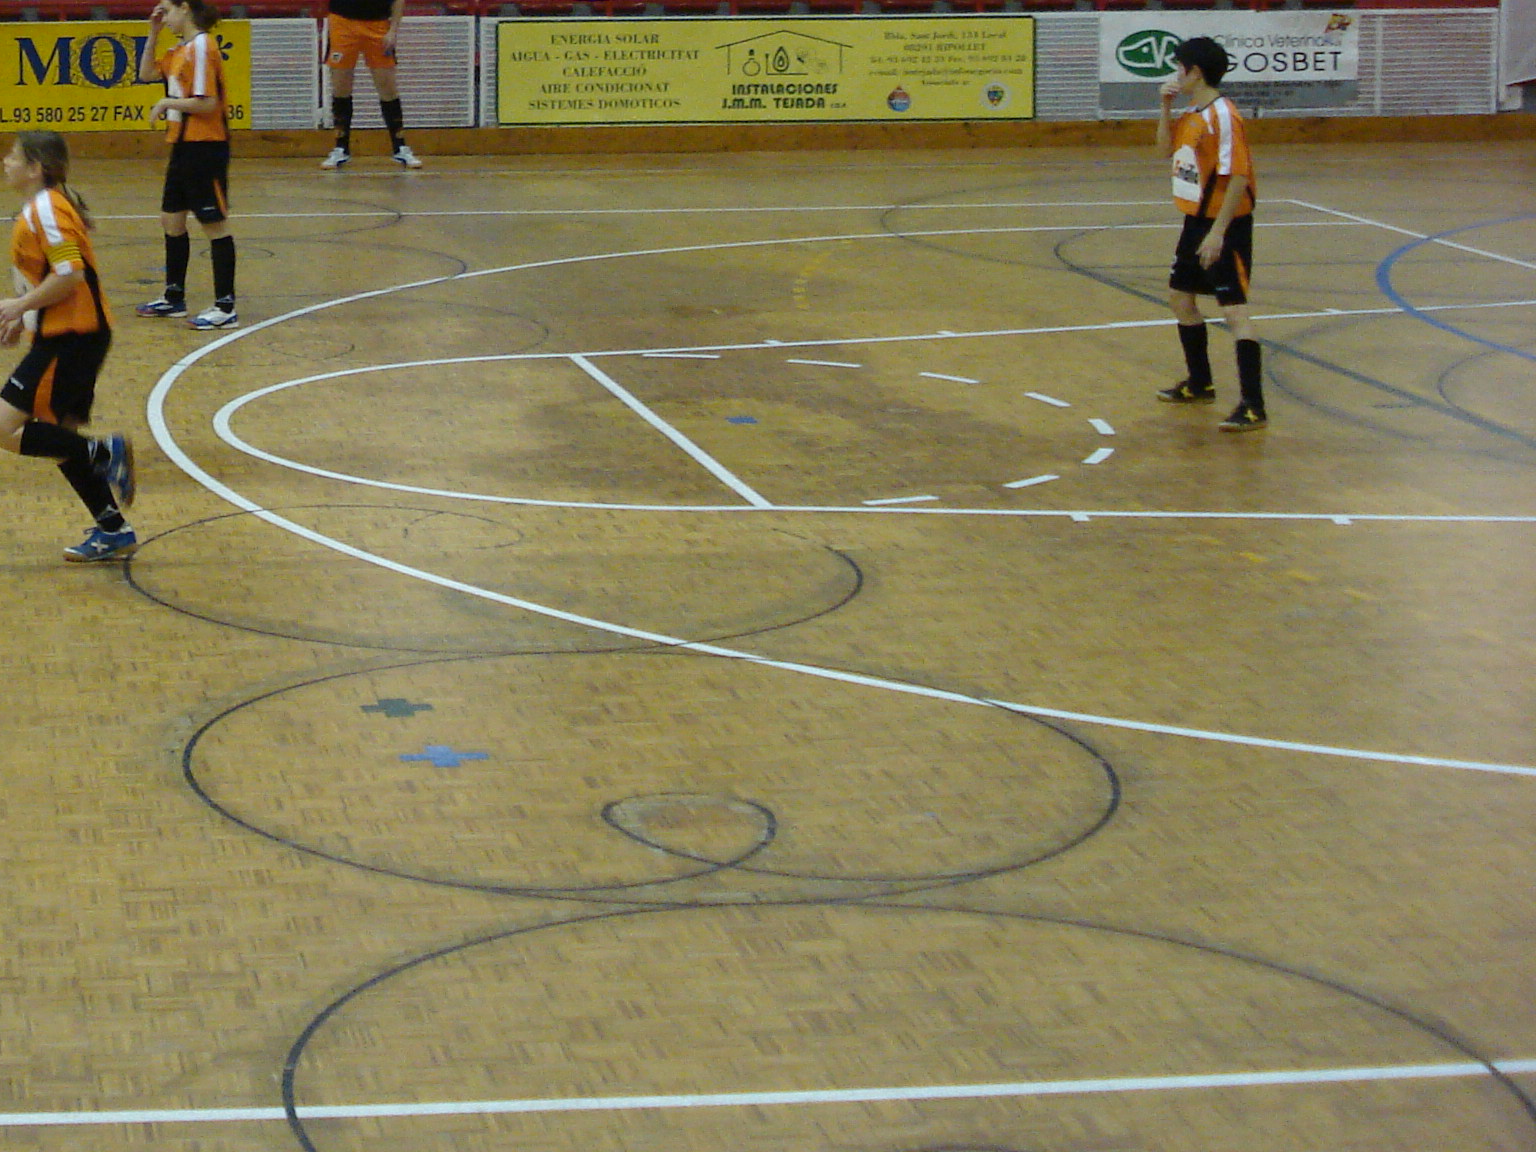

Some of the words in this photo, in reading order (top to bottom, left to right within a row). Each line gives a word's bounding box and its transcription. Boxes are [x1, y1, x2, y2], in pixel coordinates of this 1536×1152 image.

[615, 33, 661, 44] SOLAR
[510, 50, 551, 62] AIGUA
[564, 50, 590, 61] GAS
[603, 49, 700, 61] ELECTRICITAT
[540, 83, 571, 95] AIRE
[575, 83, 671, 94] CONDICIONAT
[732, 82, 839, 96] INSTALACIONES
[528, 99, 594, 110] SISTEMES
[774, 97, 826, 110] TEJADA
[36, 107, 63, 123] 580
[68, 107, 85, 122] 25
[91, 106, 108, 122] 27
[114, 105, 145, 121] FAX
